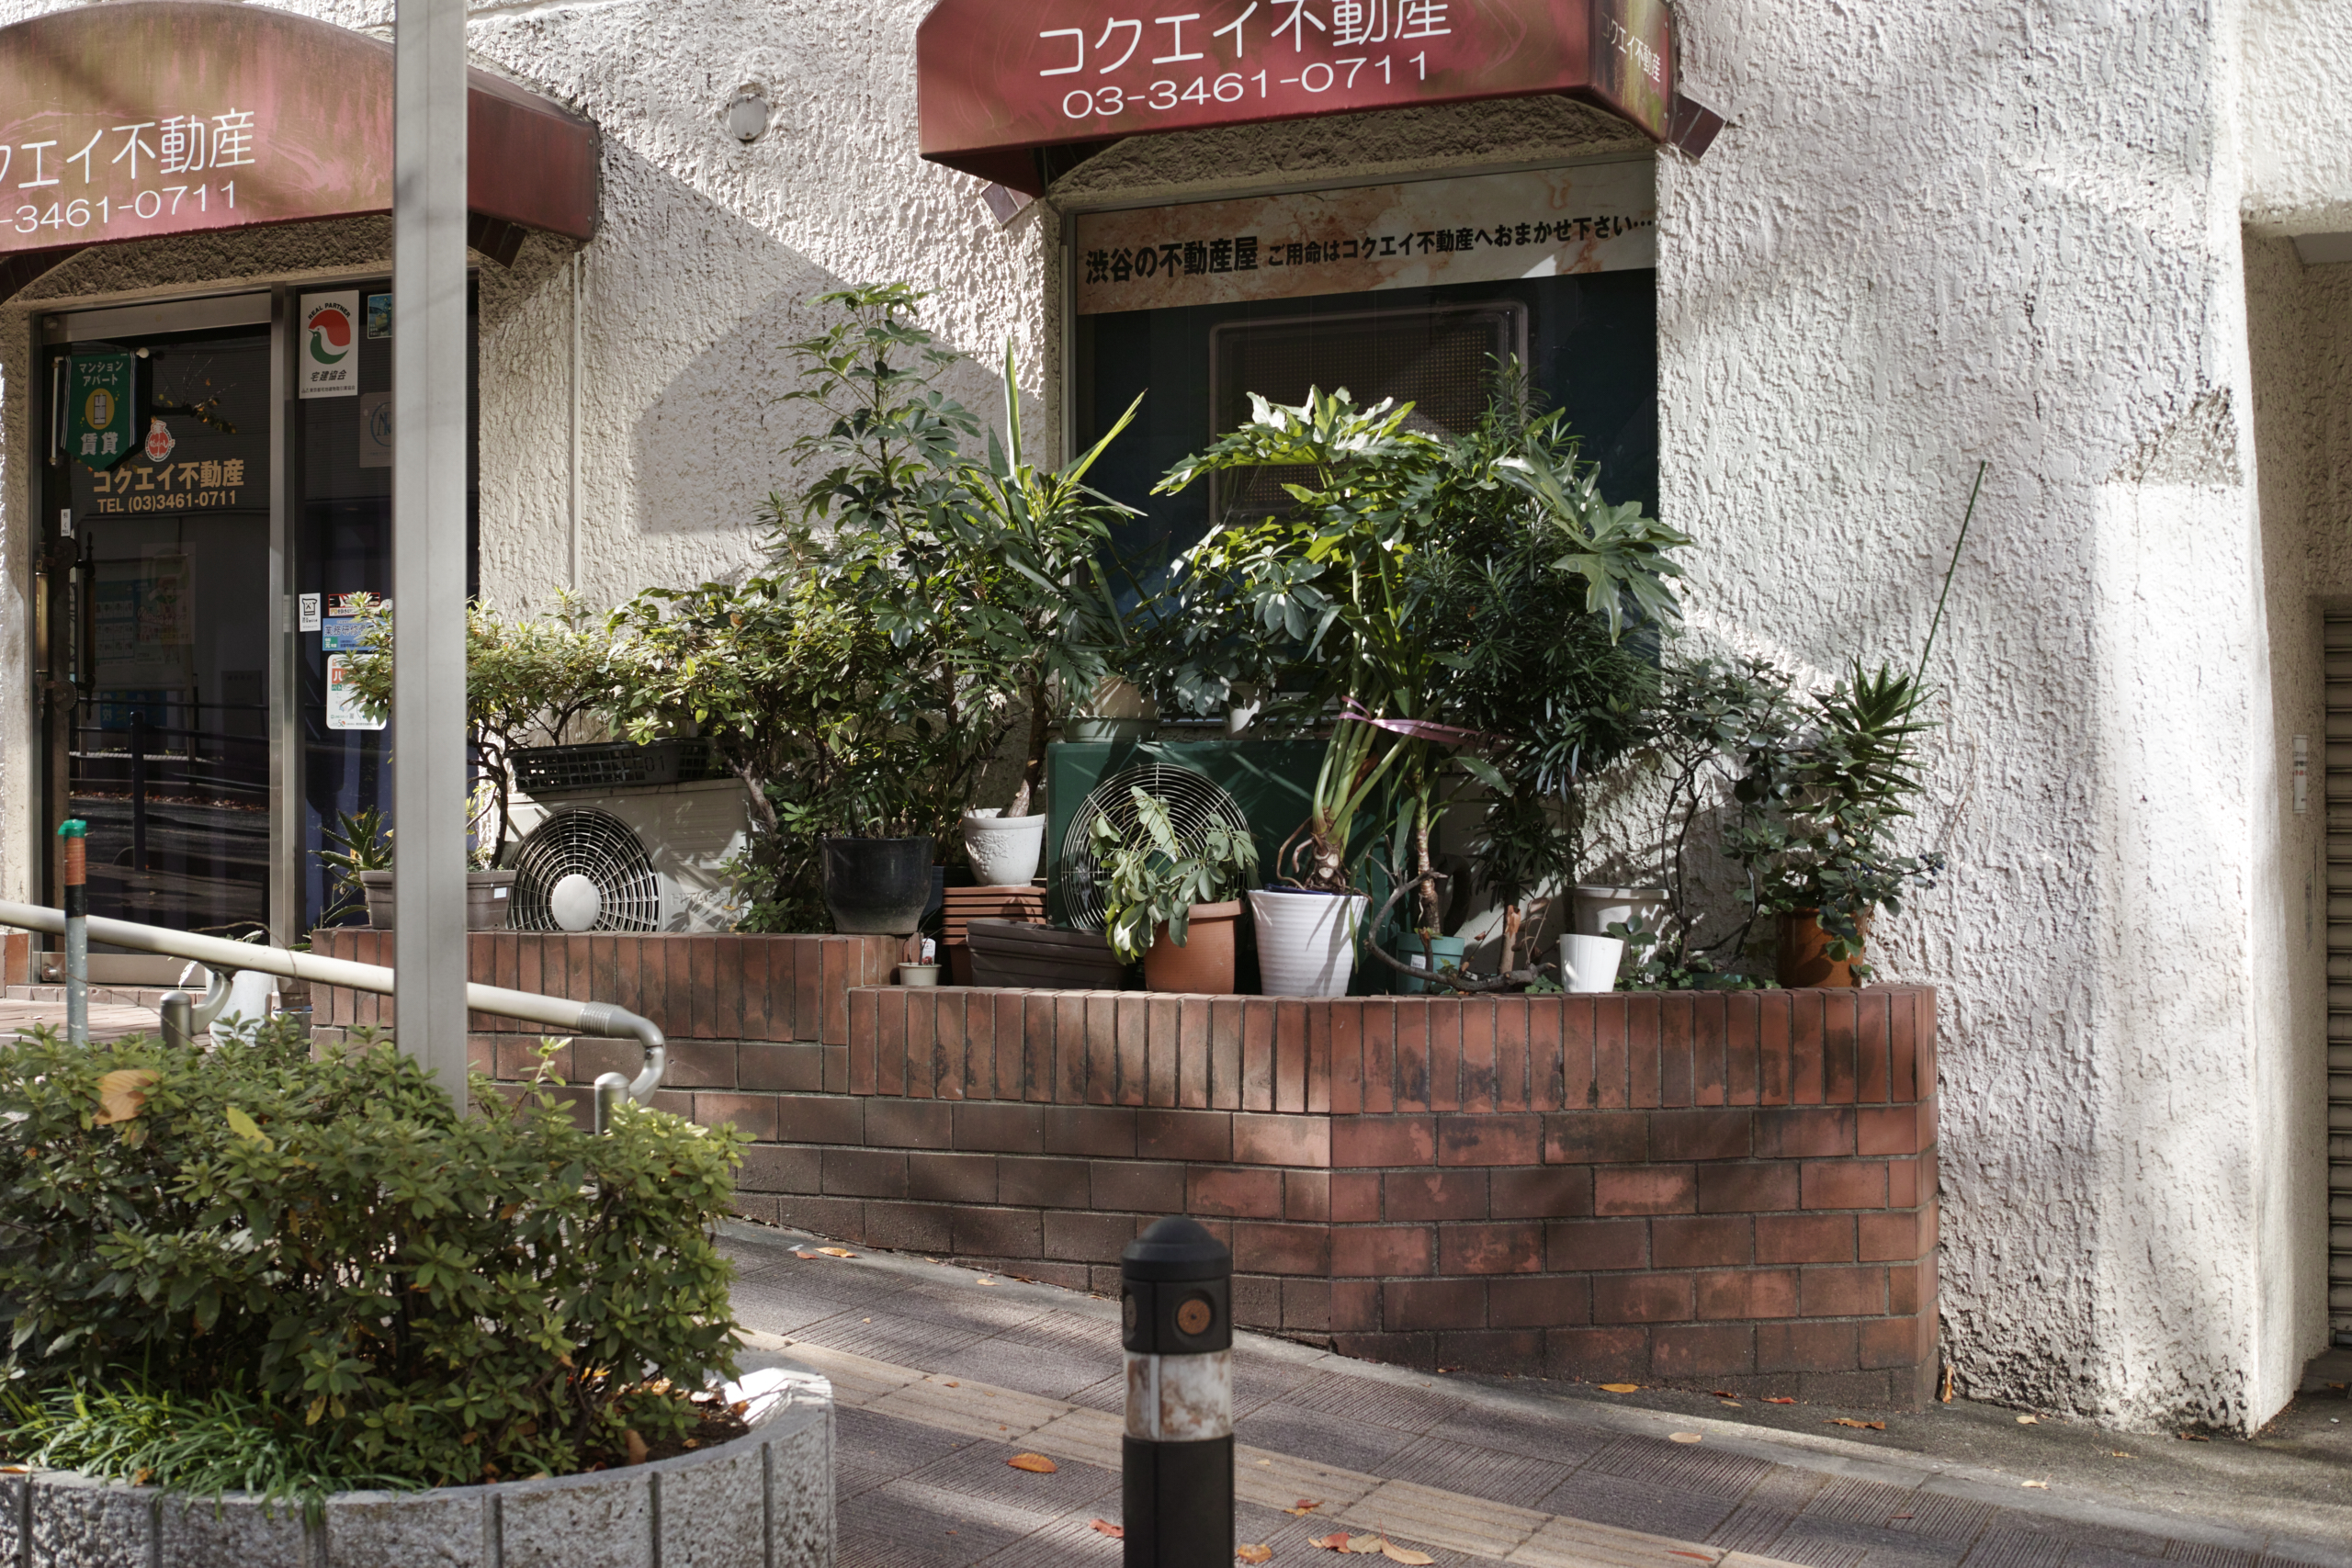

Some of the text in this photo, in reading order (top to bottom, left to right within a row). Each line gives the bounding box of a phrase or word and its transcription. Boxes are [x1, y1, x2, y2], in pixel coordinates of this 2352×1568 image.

[1039, 0, 1452, 76] コクエイ不動産
[1601, 11, 1660, 83] コクエイ不動産
[1062, 51, 1426, 118] 03-3461-0711
[0, 107, 255, 188] エイ不動産
[1085, 235, 1259, 285] 渋谷の不動産屋
[307, 302, 351, 321] REAL PARTNER
[79, 361, 124, 374] マンション
[310, 369, 347, 382] 宅建協会
[83, 374, 119, 387] アパート
[80, 431, 119, 456] 賃貸
[93, 457, 244, 495] コクエイ不動産
[96, 490, 236, 513] TEL (03)3461-0711
[670, 890, 730, 906] HITACHI
